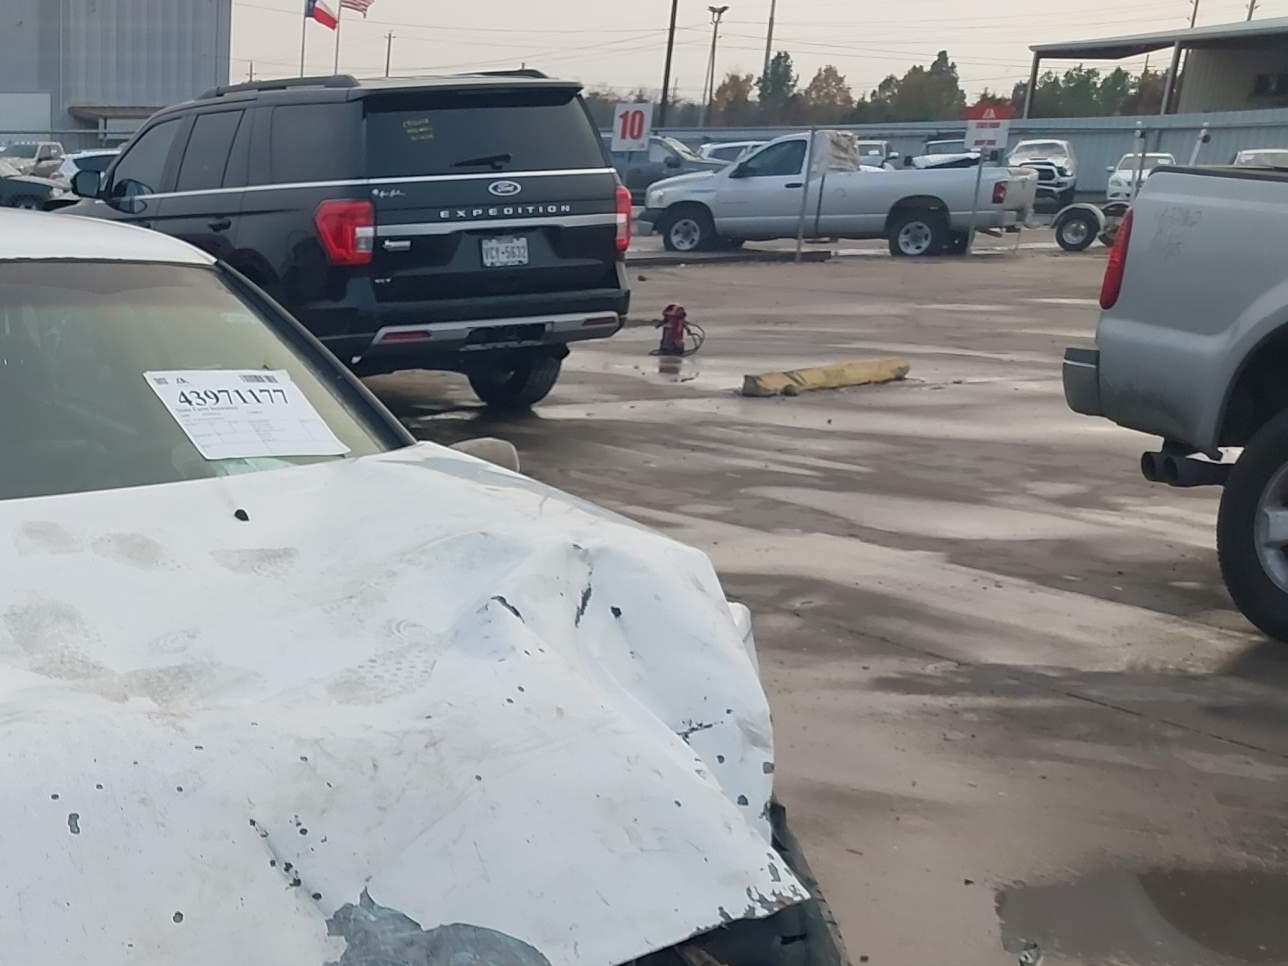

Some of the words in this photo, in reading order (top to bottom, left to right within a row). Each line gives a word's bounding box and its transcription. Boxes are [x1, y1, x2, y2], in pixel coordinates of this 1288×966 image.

[619, 110, 644, 140] 10
[439, 205, 571, 218] EXPEDITION
[177, 389, 289, 407] 43971177
